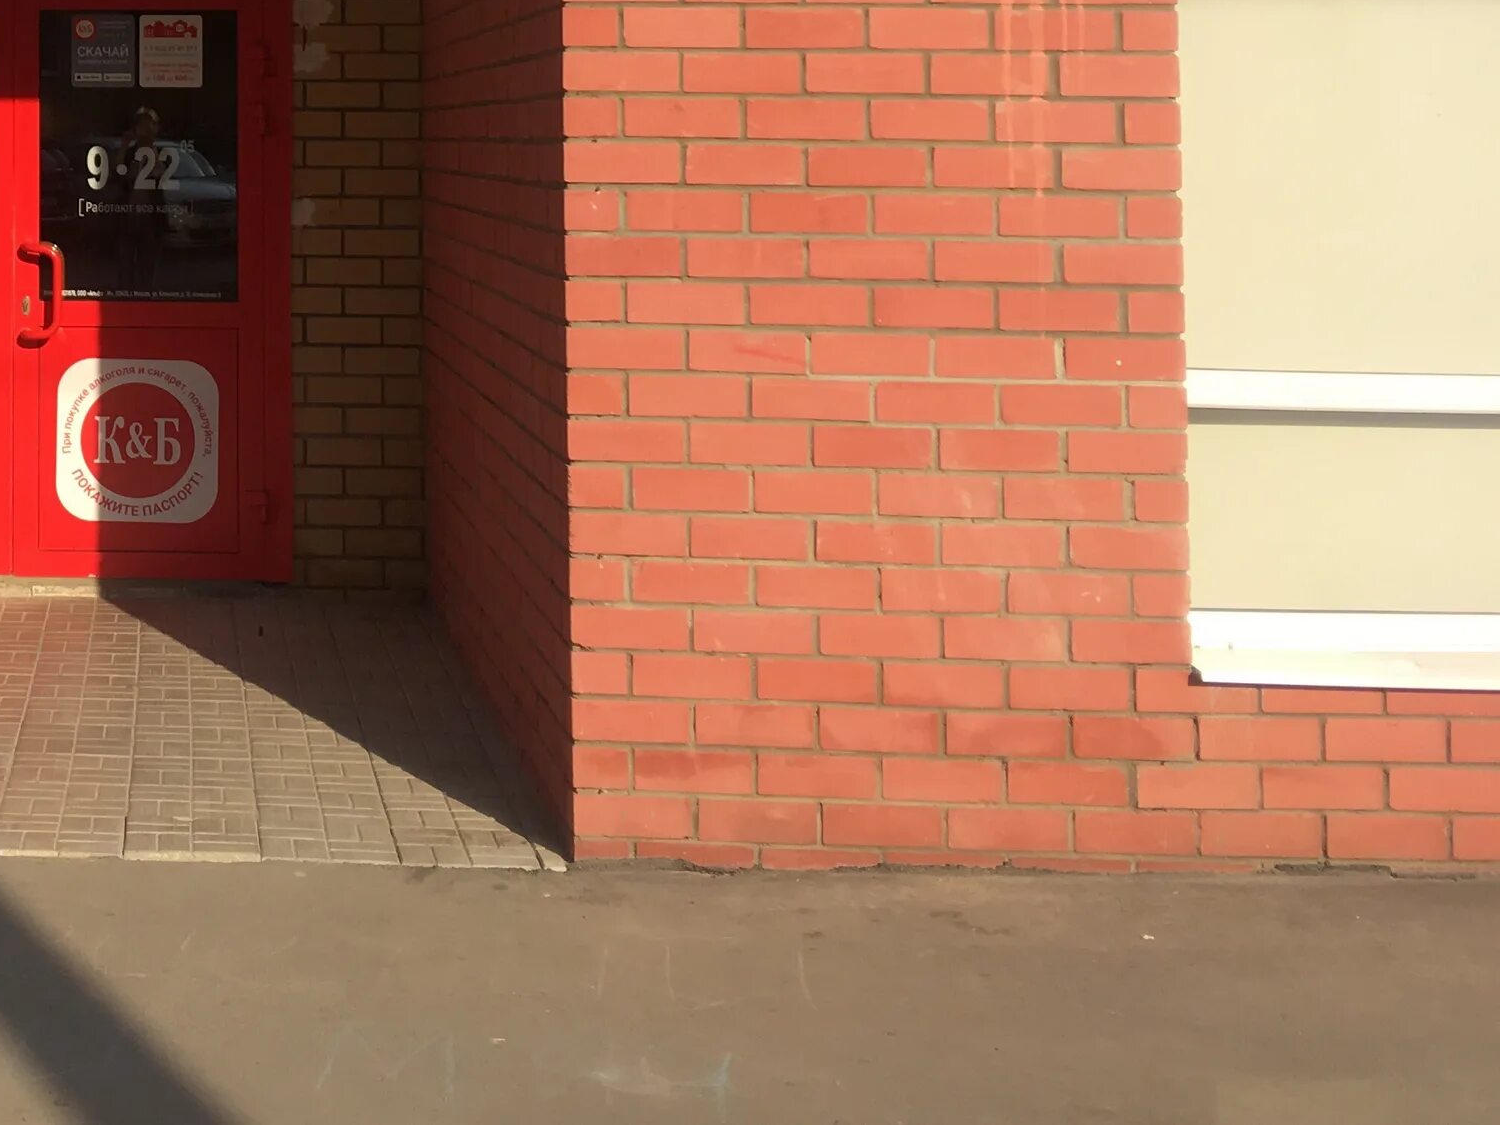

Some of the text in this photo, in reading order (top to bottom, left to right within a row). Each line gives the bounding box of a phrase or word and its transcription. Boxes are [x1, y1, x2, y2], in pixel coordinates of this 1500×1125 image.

[77, 43, 129, 59] СКАЧАЙ
[89, 366, 135, 390] алкоголя
[138, 367, 145, 375] и
[65, 388, 90, 430] покупке
[61, 433, 71, 454] При
[93, 415, 182, 466] К&Б
[71, 468, 139, 516] ПОКАЖИТЕ
